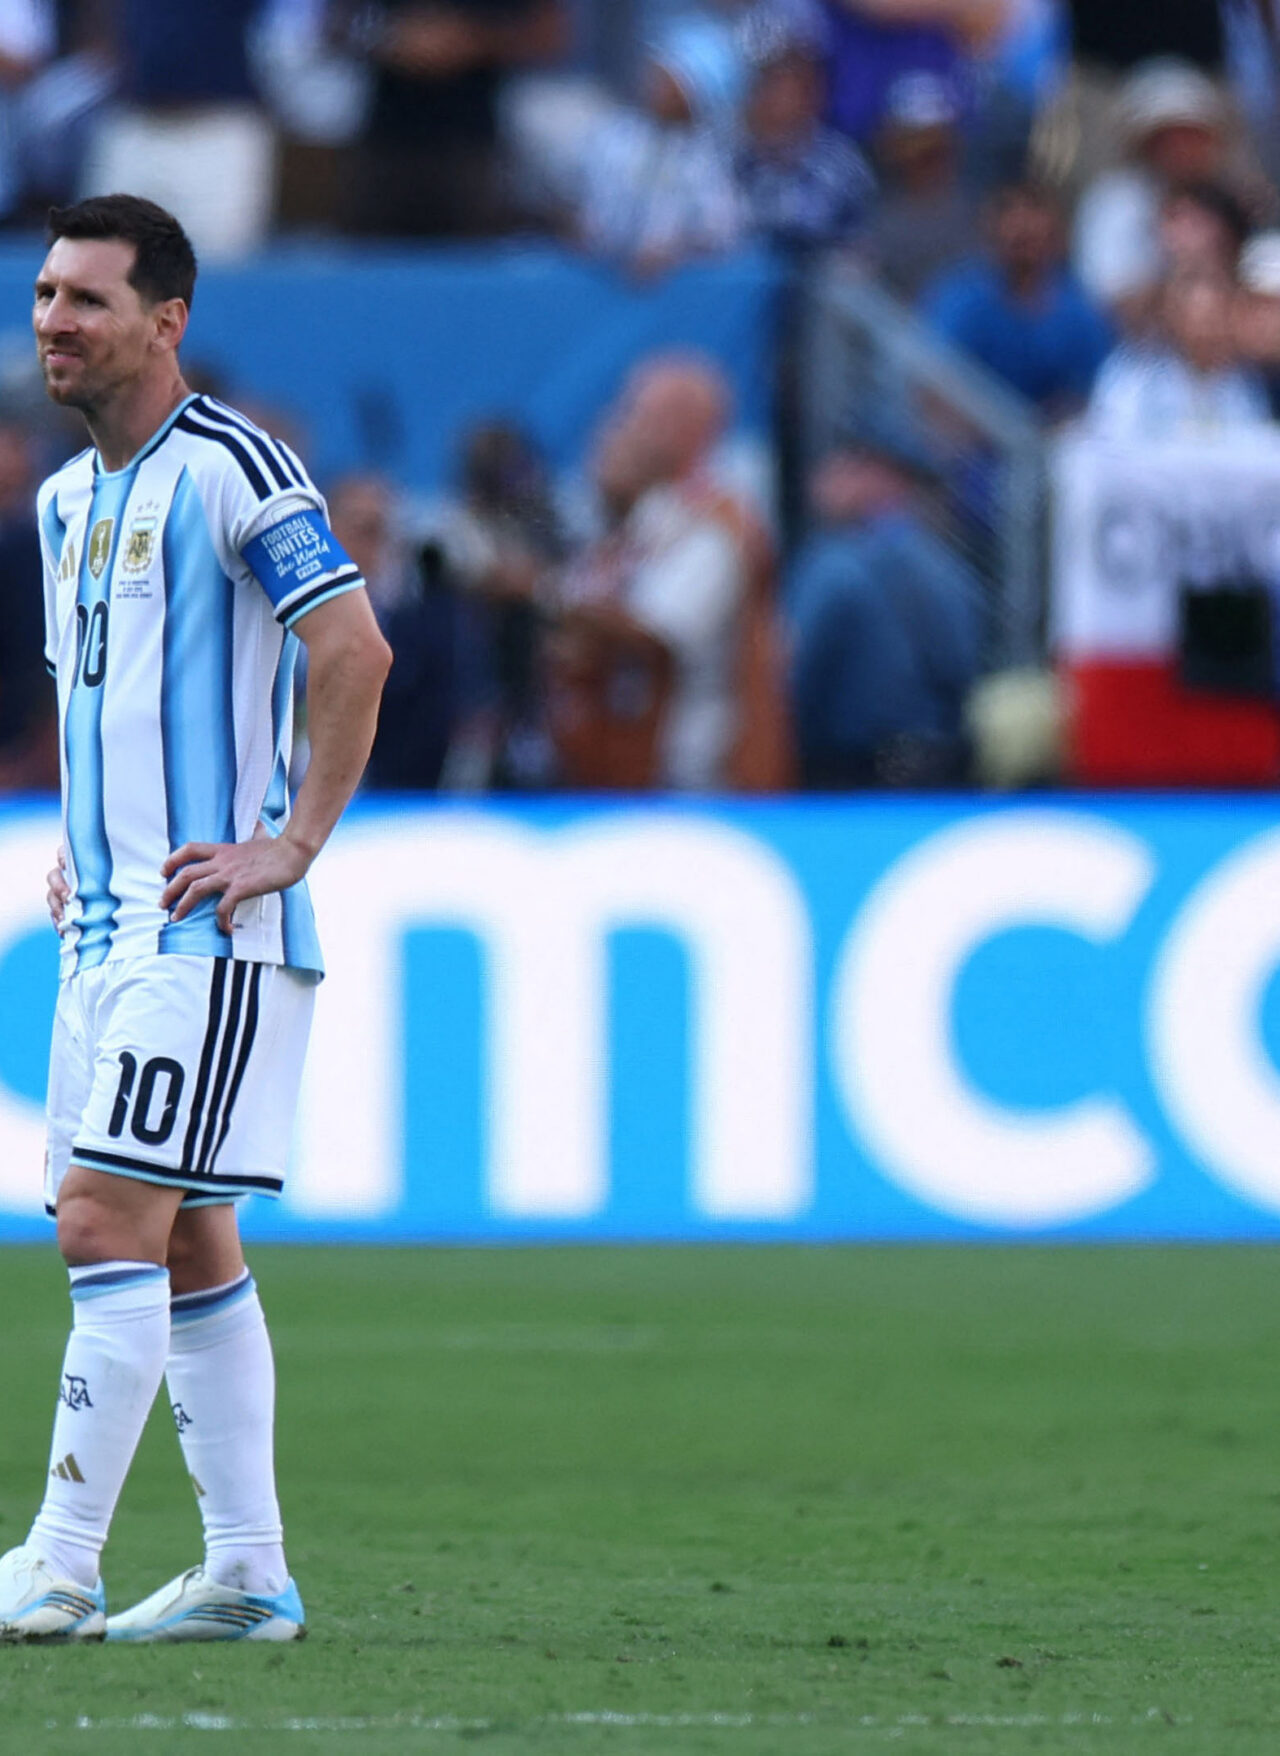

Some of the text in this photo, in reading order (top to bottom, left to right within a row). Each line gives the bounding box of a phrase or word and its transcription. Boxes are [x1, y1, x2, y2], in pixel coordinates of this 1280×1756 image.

[261, 515, 311, 549] FOOTBALL
[268, 527, 320, 562] UNITES
[276, 538, 331, 578] the World
[108, 1050, 186, 1147] 10
